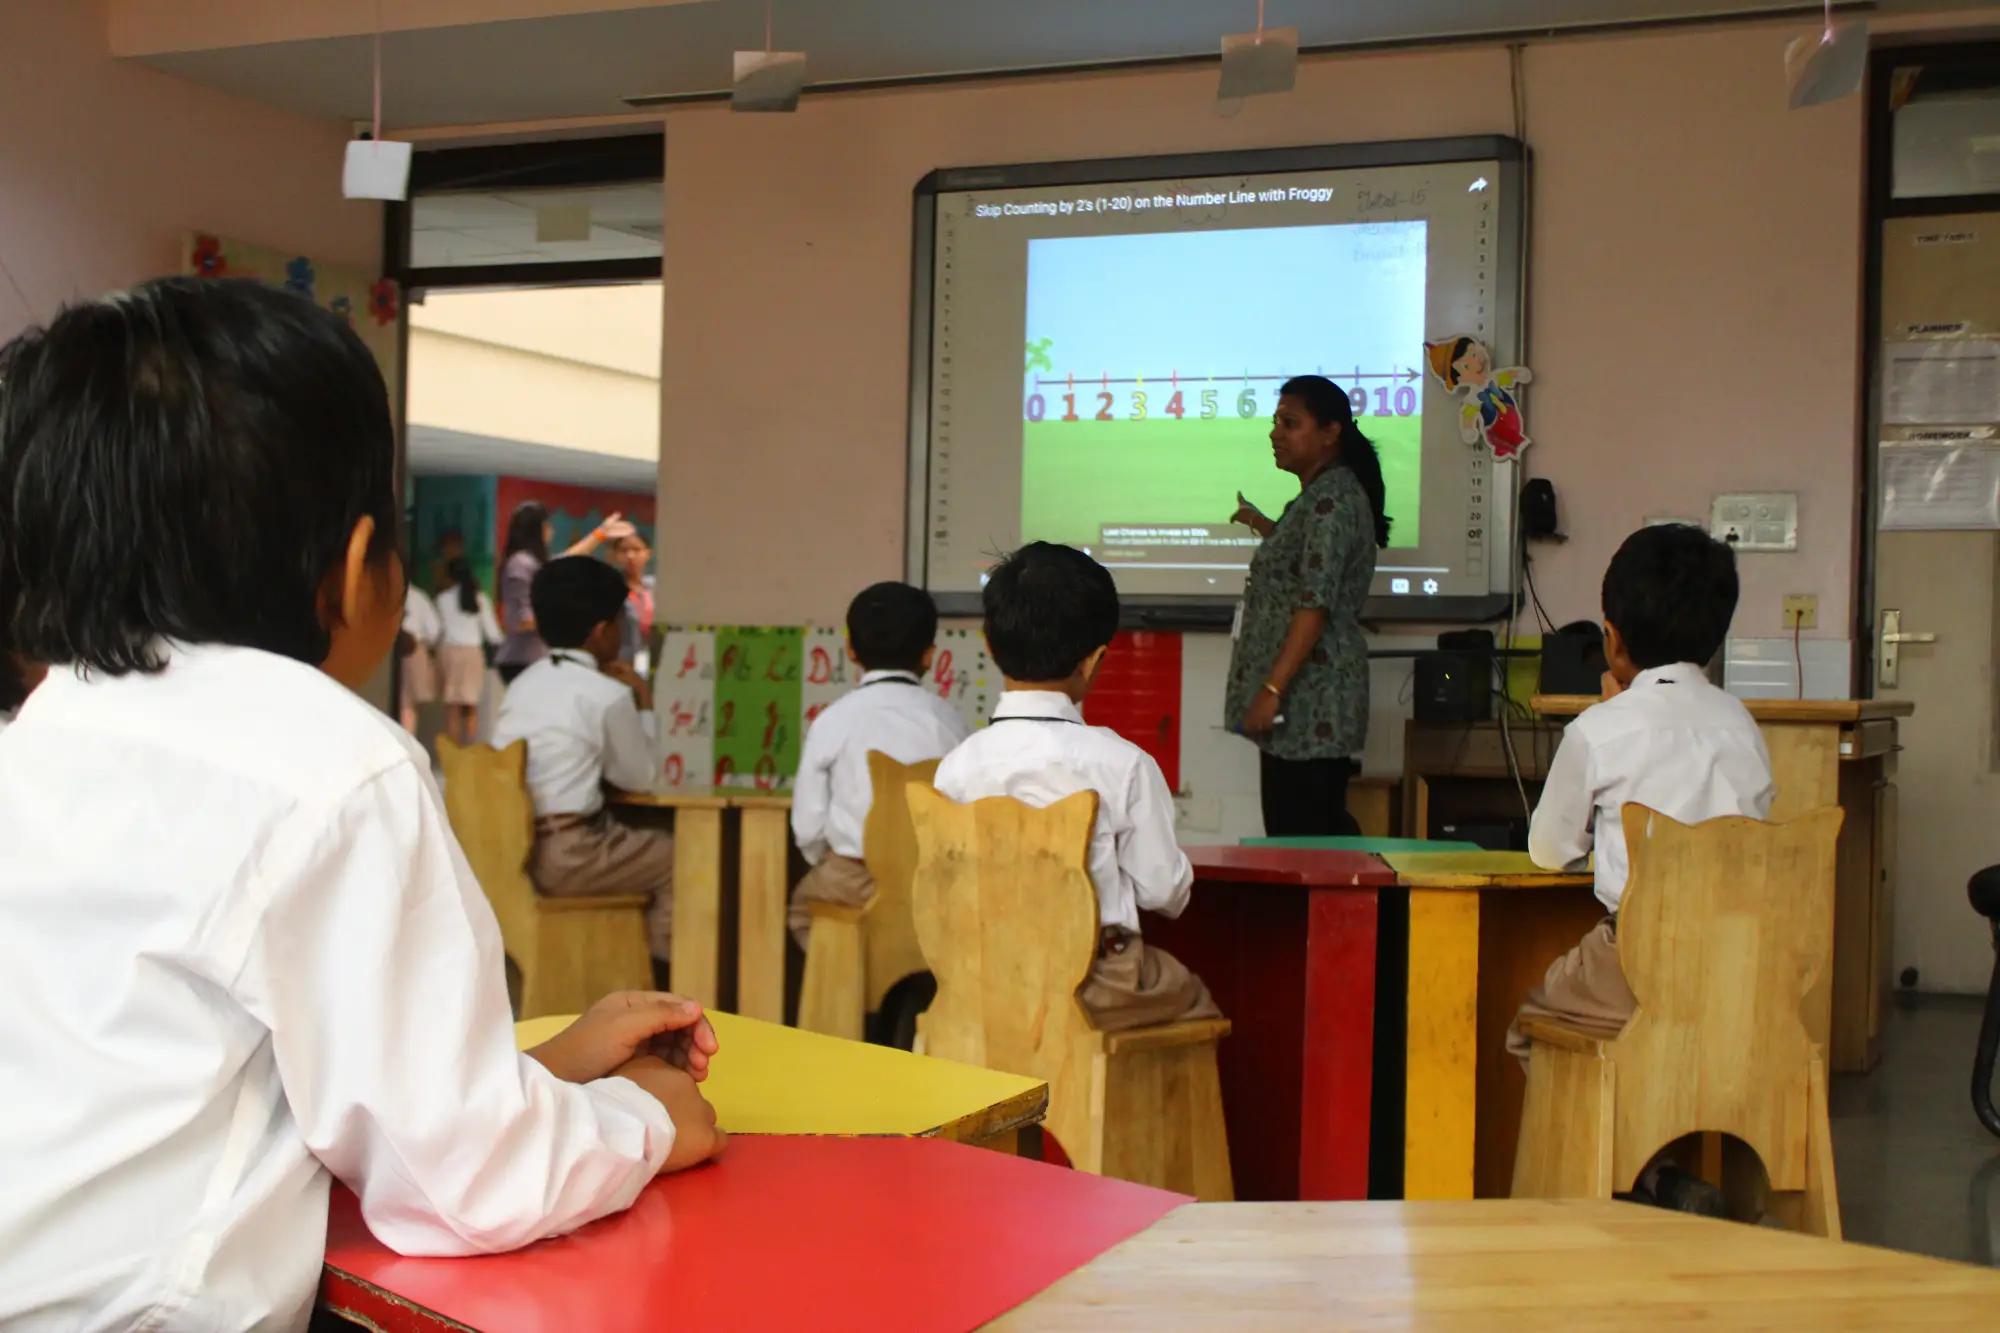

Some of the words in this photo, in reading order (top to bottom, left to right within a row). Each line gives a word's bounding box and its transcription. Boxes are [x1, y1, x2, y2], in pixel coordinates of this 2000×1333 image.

[975, 204, 1001, 218] Skip
[1003, 202, 1057, 216] Counting
[1059, 200, 1073, 214] by
[1076, 199, 1093, 212] 2's
[1095, 195, 1133, 213] (1-20)
[1134, 197, 1150, 209] on
[1153, 194, 1173, 207] the
[1176, 192, 1226, 207] Number
[1229, 190, 1256, 204] Line
[1258, 188, 1286, 202] with
[1288, 187, 1334, 203] Froggy
[1026, 393, 1045, 422] 0
[1062, 393, 1078, 421] 1
[1095, 391, 1114, 421] 2
[1130, 391, 1147, 421] 3
[1165, 390, 1185, 419] 4
[1200, 389, 1219, 420] 5
[1237, 388, 1257, 419] 6
[1349, 387, 1368, 417] 9
[1374, 386, 1416, 417] 10
[1471, 494, 1482, 504] 19
[1470, 512, 1482, 521] 20
